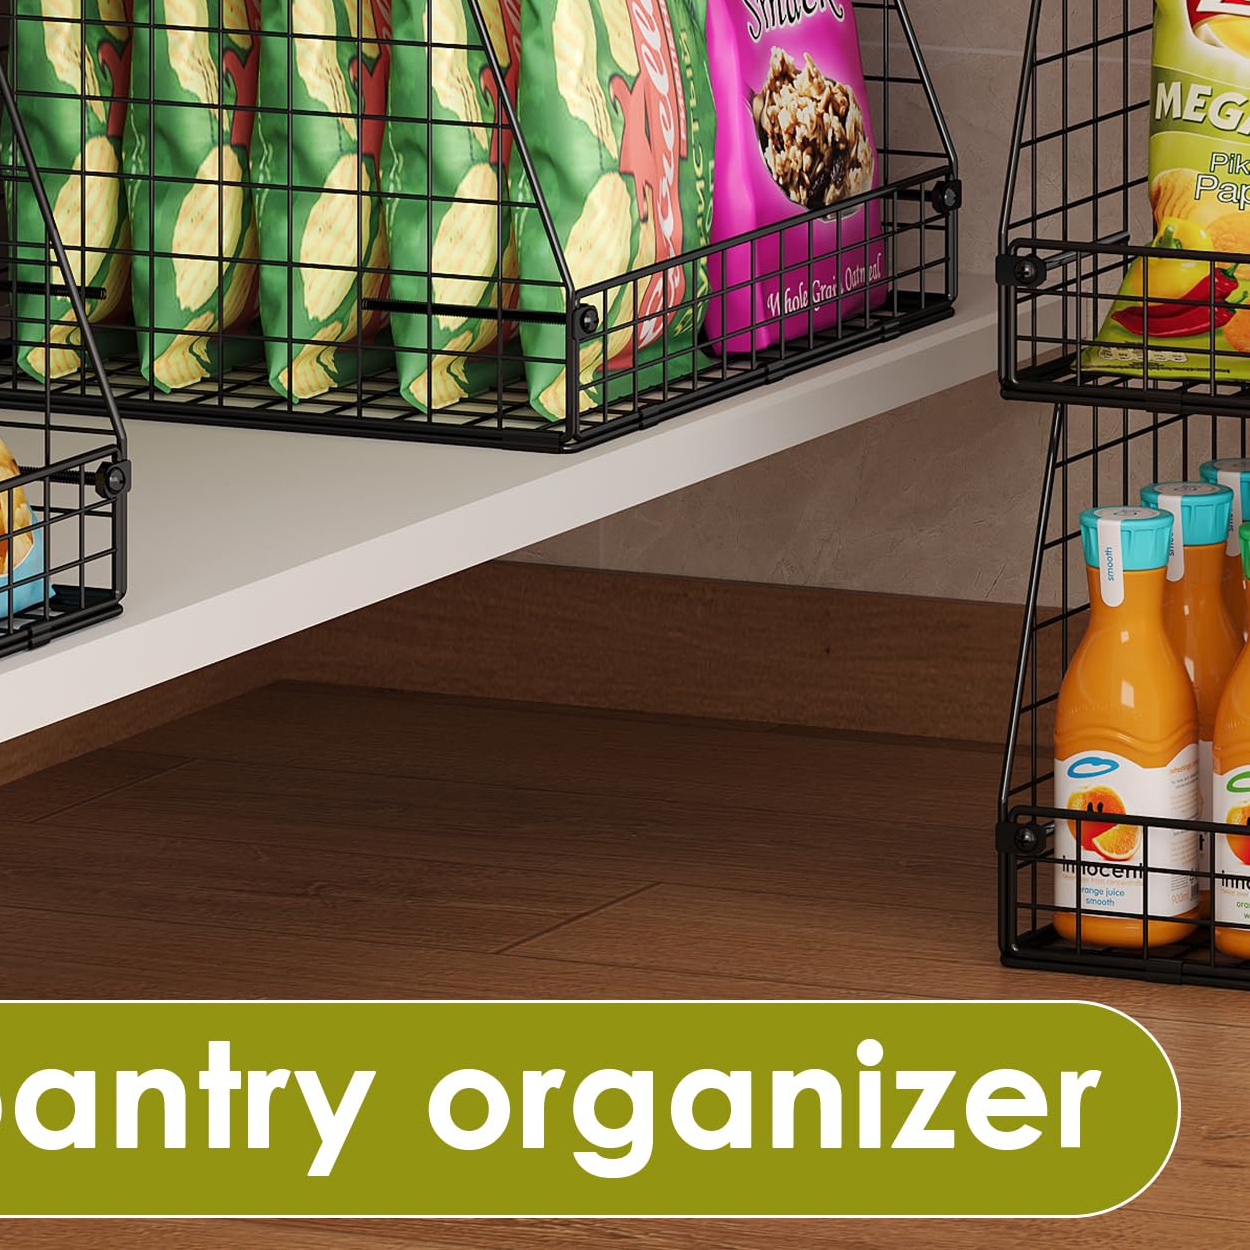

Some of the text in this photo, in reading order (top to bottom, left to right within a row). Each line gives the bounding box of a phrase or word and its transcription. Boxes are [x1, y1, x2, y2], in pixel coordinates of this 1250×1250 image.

[767, 280, 808, 317] Whole
[1104, 546, 1114, 582] smooth
[1085, 896, 1115, 907] smooth
[1106, 887, 1125, 897] juice
